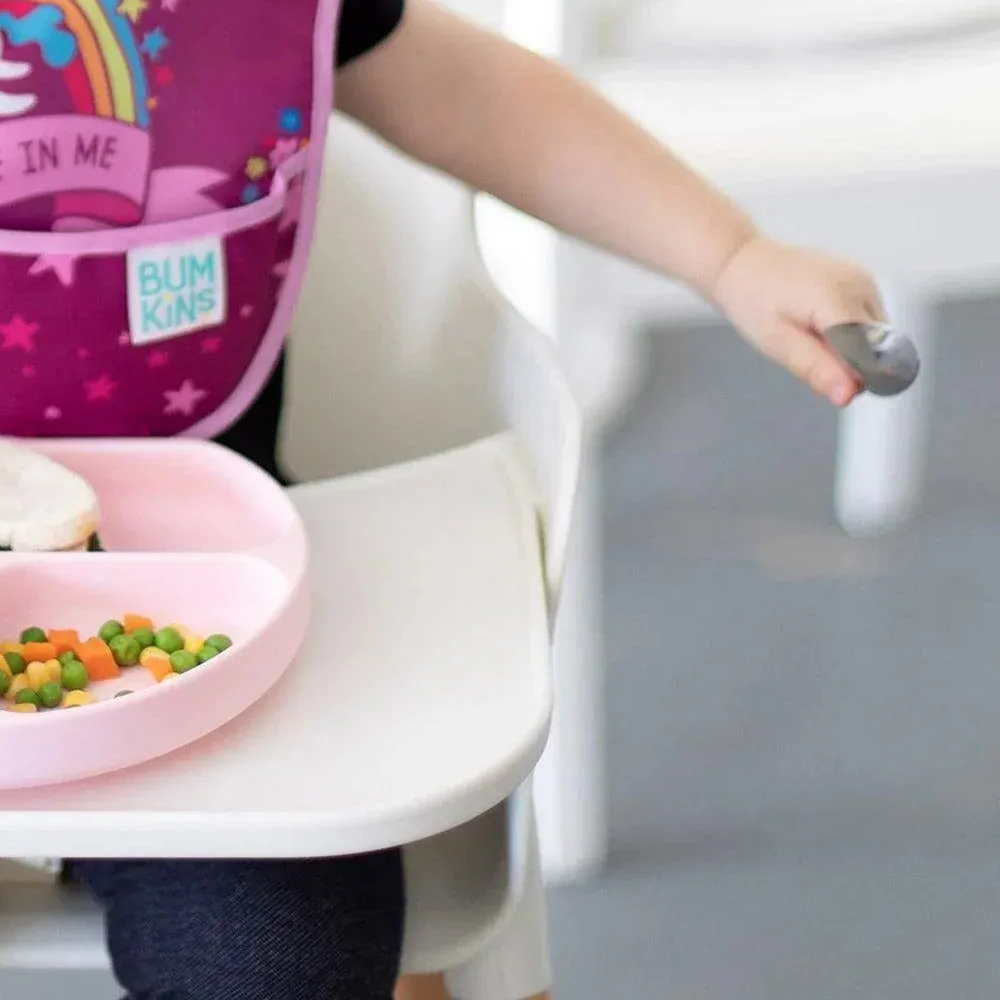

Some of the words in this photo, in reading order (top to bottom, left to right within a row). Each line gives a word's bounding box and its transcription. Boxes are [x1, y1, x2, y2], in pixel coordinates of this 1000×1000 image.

[18, 135, 59, 174] IN
[74, 133, 118, 169] ME
[138, 251, 216, 296] BUM
